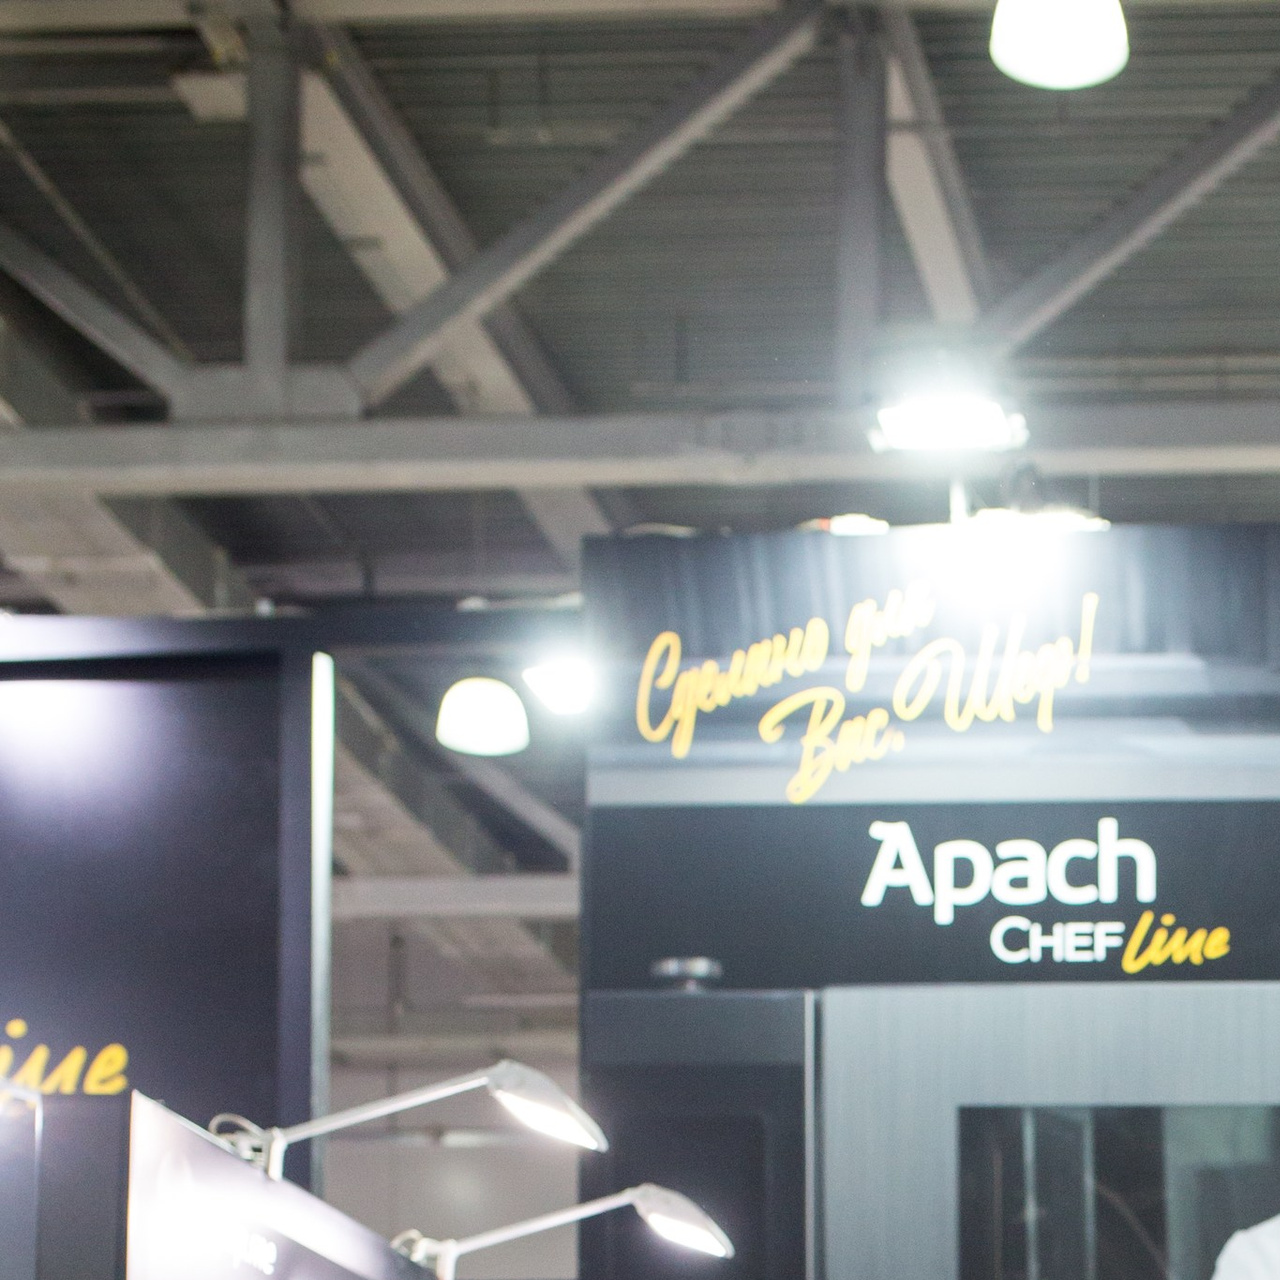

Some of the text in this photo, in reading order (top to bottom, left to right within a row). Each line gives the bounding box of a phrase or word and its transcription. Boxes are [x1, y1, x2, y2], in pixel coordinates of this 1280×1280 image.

[892, 592, 1100, 733] Шеф!
[861, 817, 1157, 925] Apach
[989, 915, 1126, 964] CHEF
[0, 1018, 129, 1112] ine
